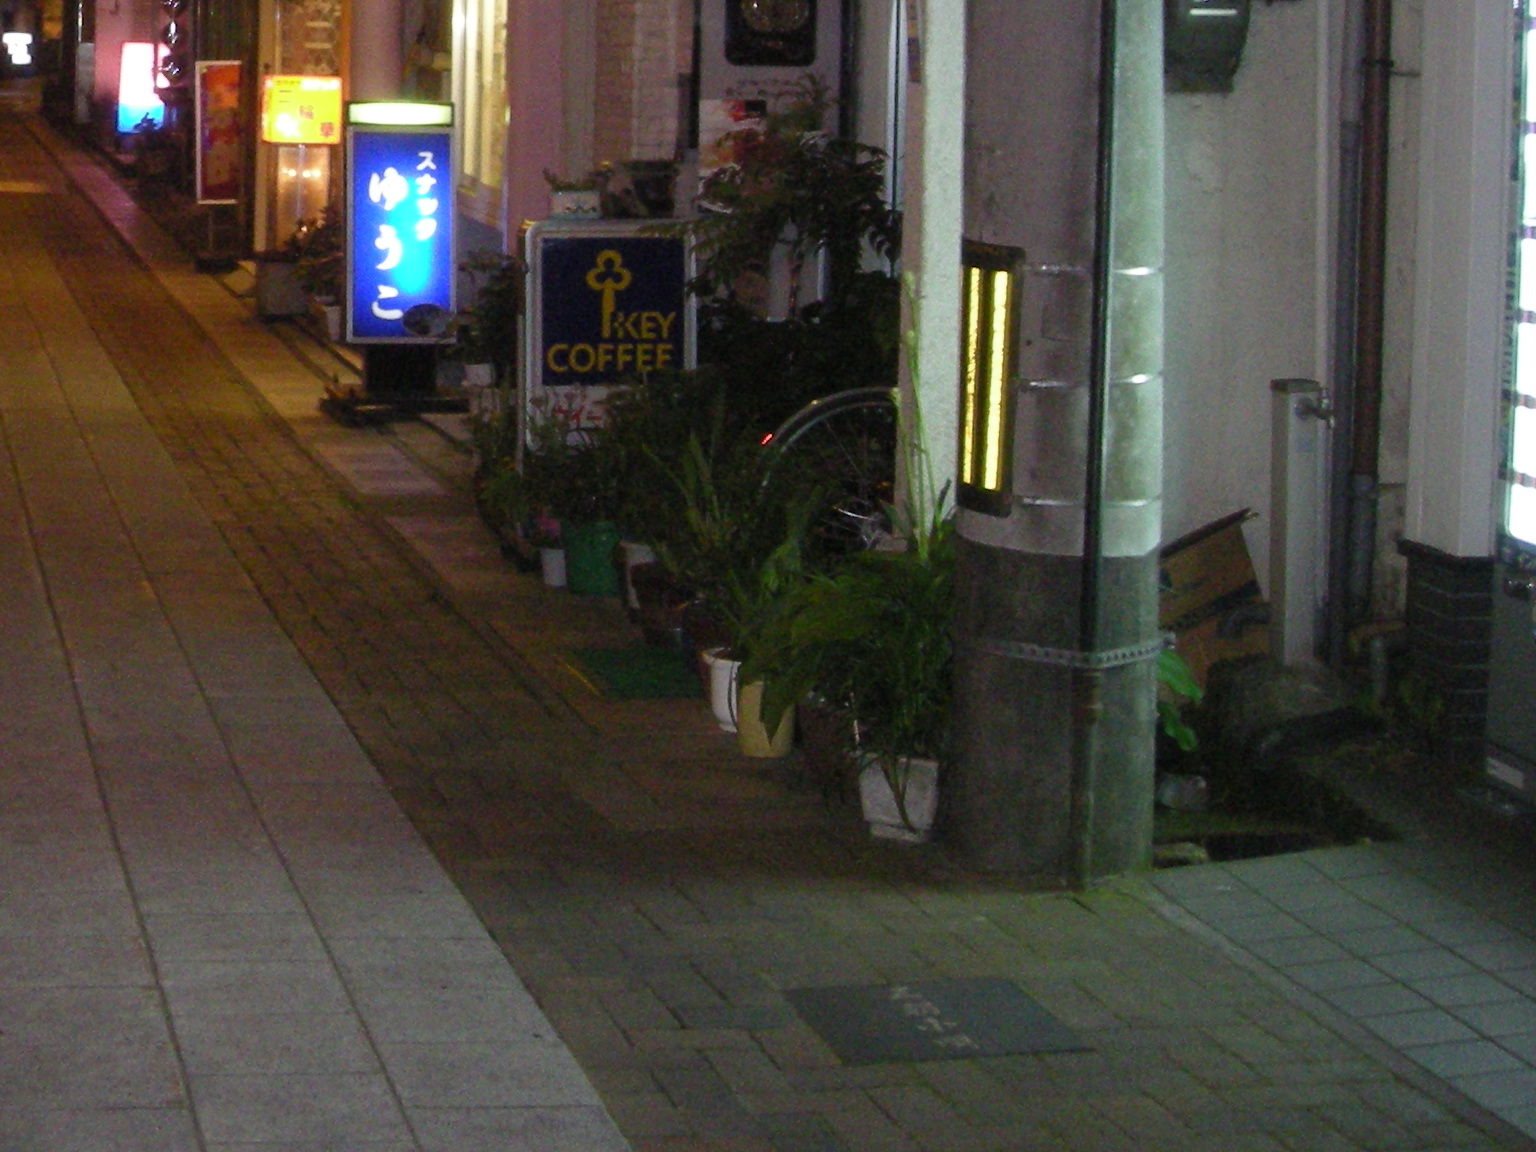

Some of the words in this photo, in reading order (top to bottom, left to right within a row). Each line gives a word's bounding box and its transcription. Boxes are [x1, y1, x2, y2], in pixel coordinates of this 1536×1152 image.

[368, 166, 410, 321] ゆうこ
[608, 310, 678, 340] KEY
[545, 342, 674, 373] COFFEE
